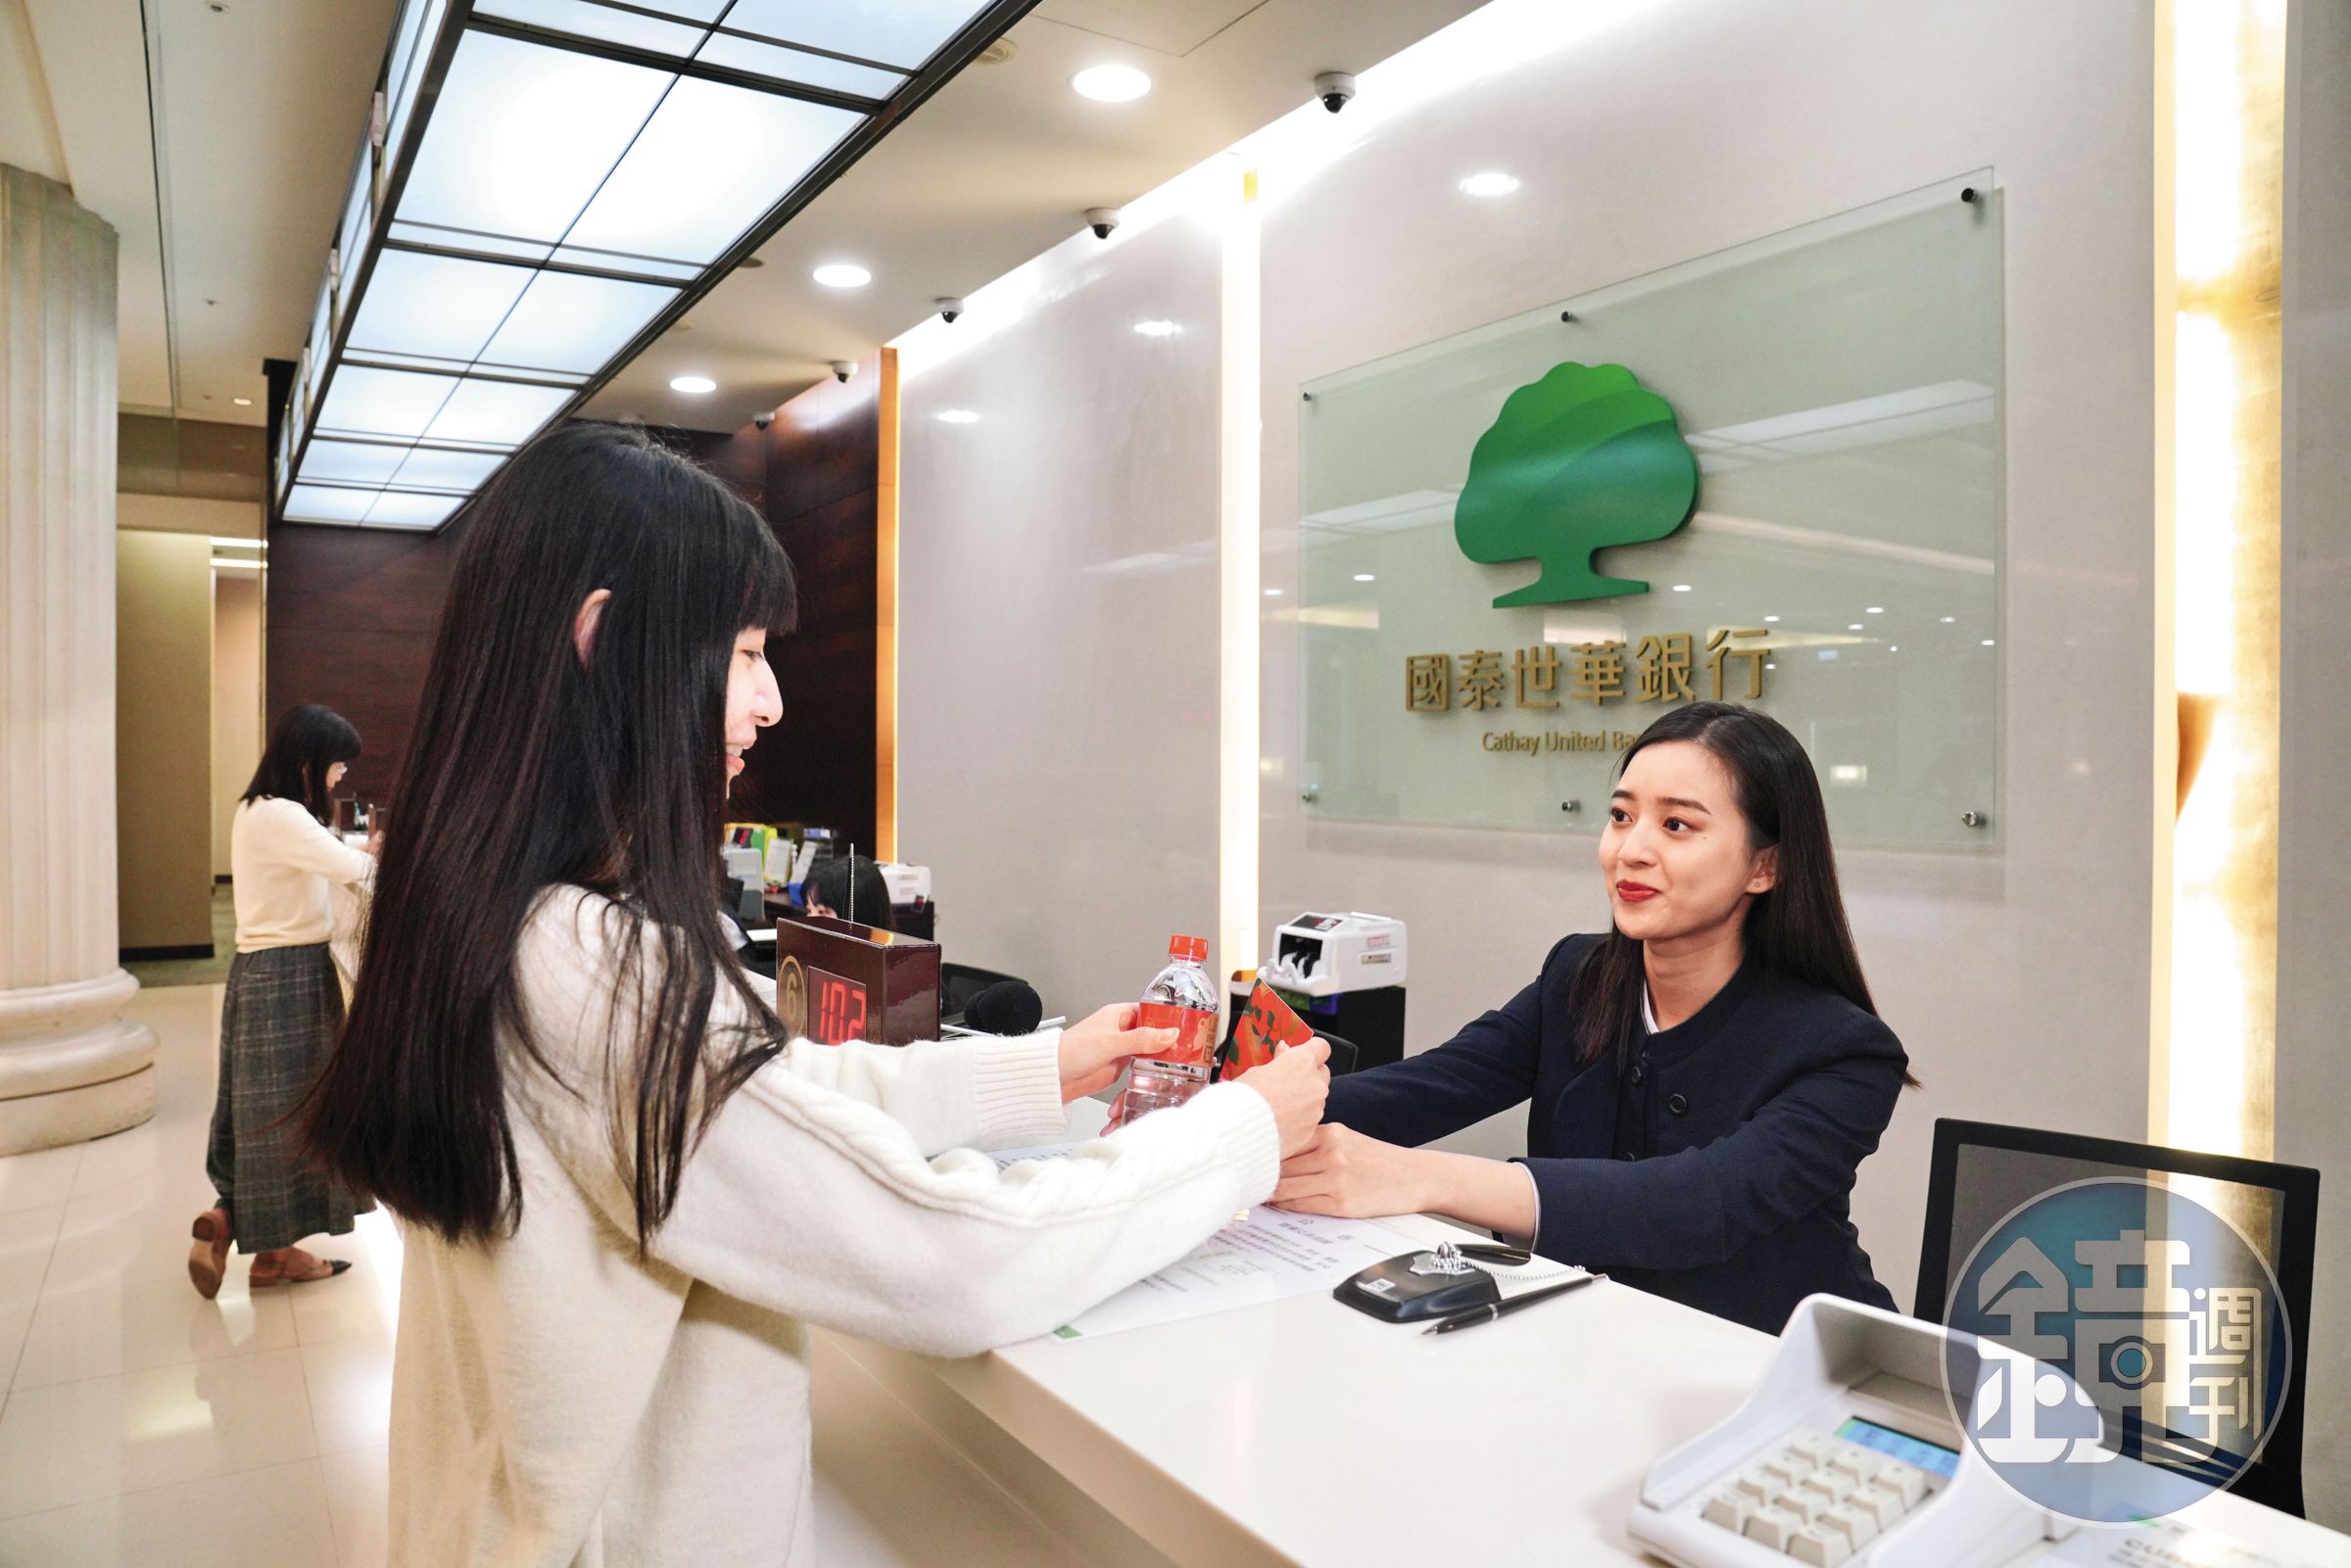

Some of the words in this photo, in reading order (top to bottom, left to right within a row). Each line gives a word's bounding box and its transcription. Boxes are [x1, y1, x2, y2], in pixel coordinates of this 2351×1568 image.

[1405, 628, 1771, 713] 國泰世華銀行
[1482, 732, 1540, 757] Cathay
[1545, 731, 1607, 752] United
[1612, 732, 1640, 752] Ba
[787, 973, 797, 1022] 6
[819, 981, 866, 1046] 102
